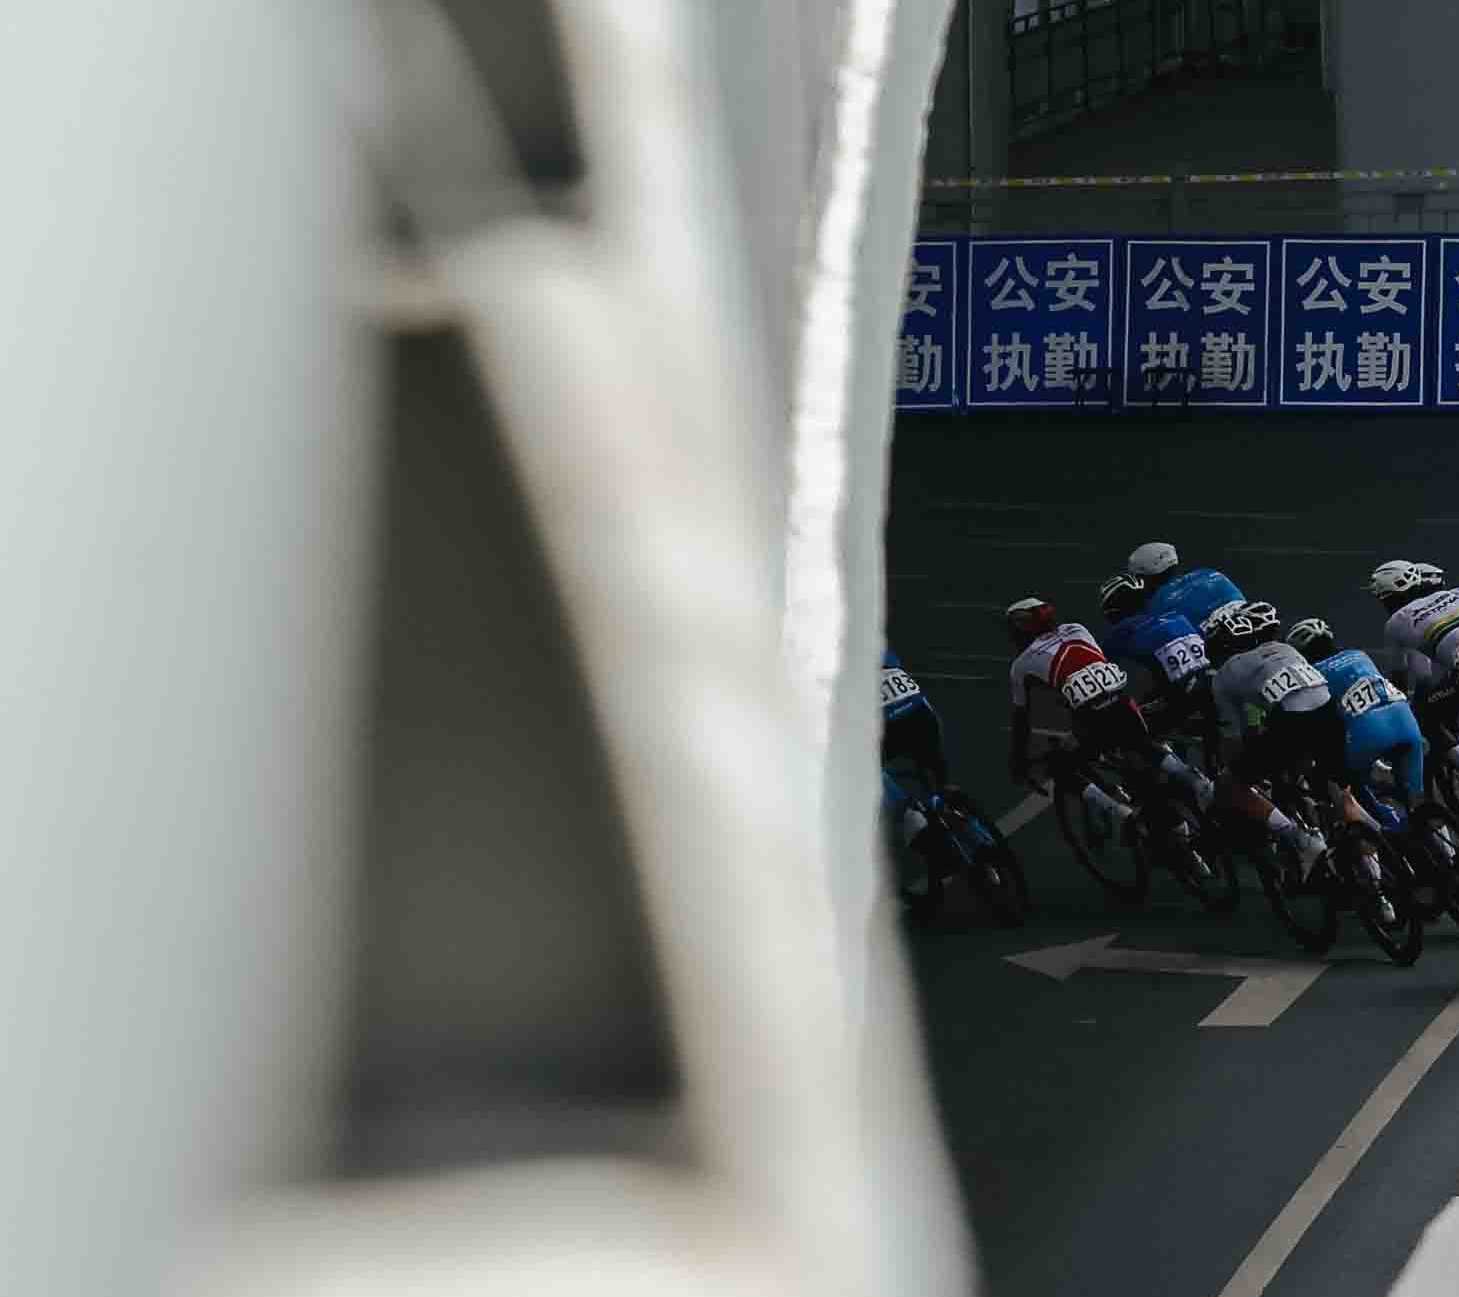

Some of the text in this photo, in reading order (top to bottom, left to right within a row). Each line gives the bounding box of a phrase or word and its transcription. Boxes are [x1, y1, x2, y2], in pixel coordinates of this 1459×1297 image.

[984, 255, 1103, 313] 公安
[1140, 256, 1255, 314] 公安
[1296, 255, 1413, 314] 公安
[984, 331, 1099, 394] 执勤
[1140, 331, 1255, 392] 执勤
[1296, 331, 1411, 391] 执勤
